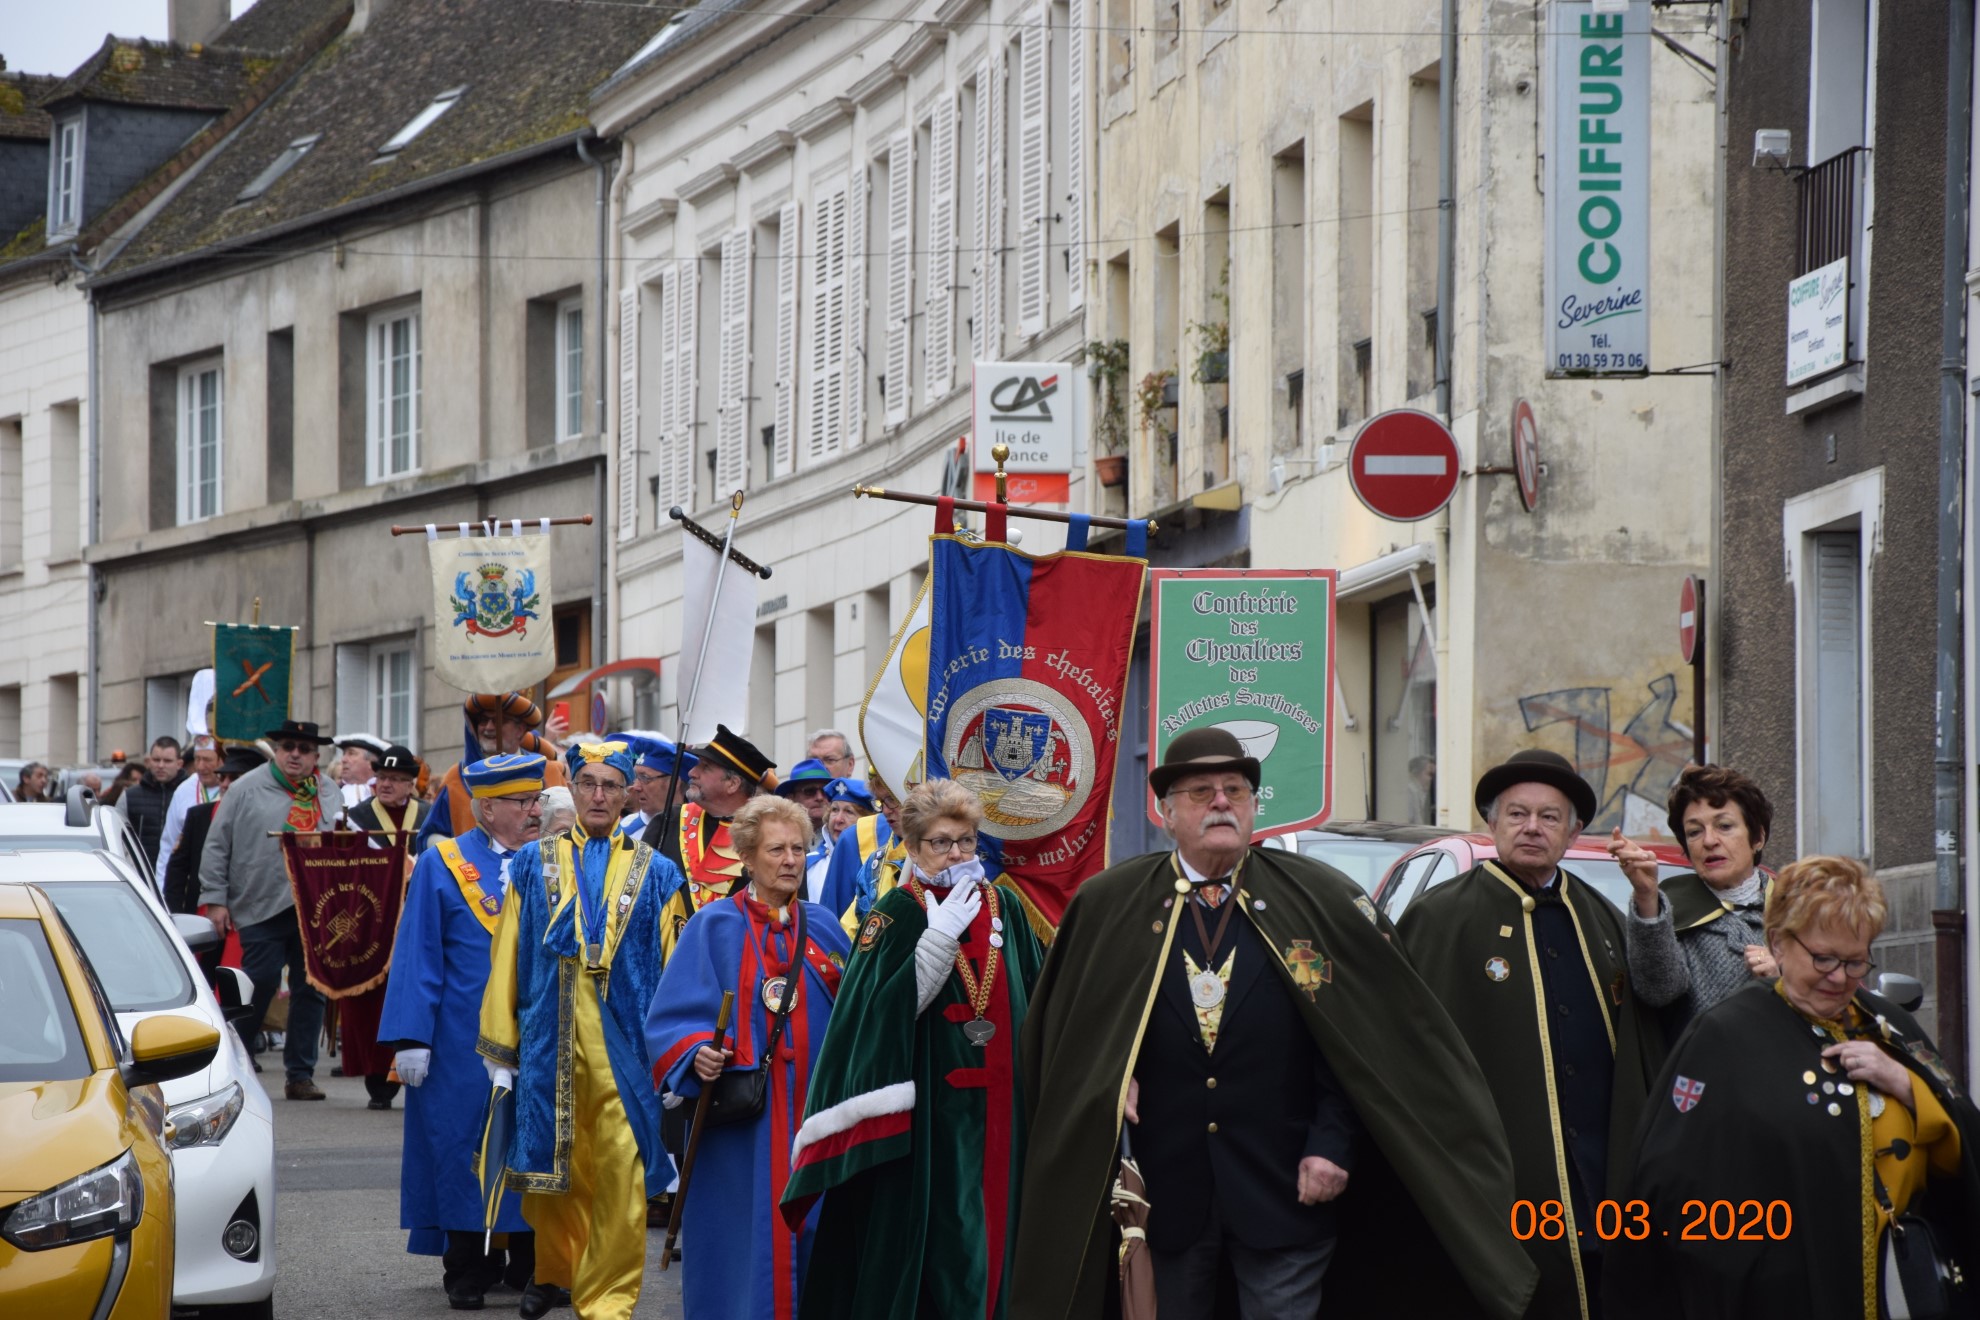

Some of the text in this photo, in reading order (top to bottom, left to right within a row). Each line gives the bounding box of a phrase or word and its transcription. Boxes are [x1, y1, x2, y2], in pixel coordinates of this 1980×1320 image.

[1578, 13, 1623, 284] COIFFURE
[1791, 276, 1820, 307] COIFFURE
[1558, 286, 1643, 329] Severine
[1590, 333, 1612, 348] Tél.
[1559, 353, 1643, 367] 01 30 59 73 06
[1021, 430, 1041, 444] de
[1009, 450, 1049, 463] ance
[1192, 588, 1298, 615] Confrérie
[1229, 618, 1259, 636] des
[1185, 637, 1303, 666] Chevaliers
[1228, 664, 1258, 683] des
[997, 638, 1037, 660] des
[1044, 648, 1118, 742] chevaliers
[1161, 687, 1321, 737] Rillettes Sarthoises
[1000, 819, 1097, 867] de melun
